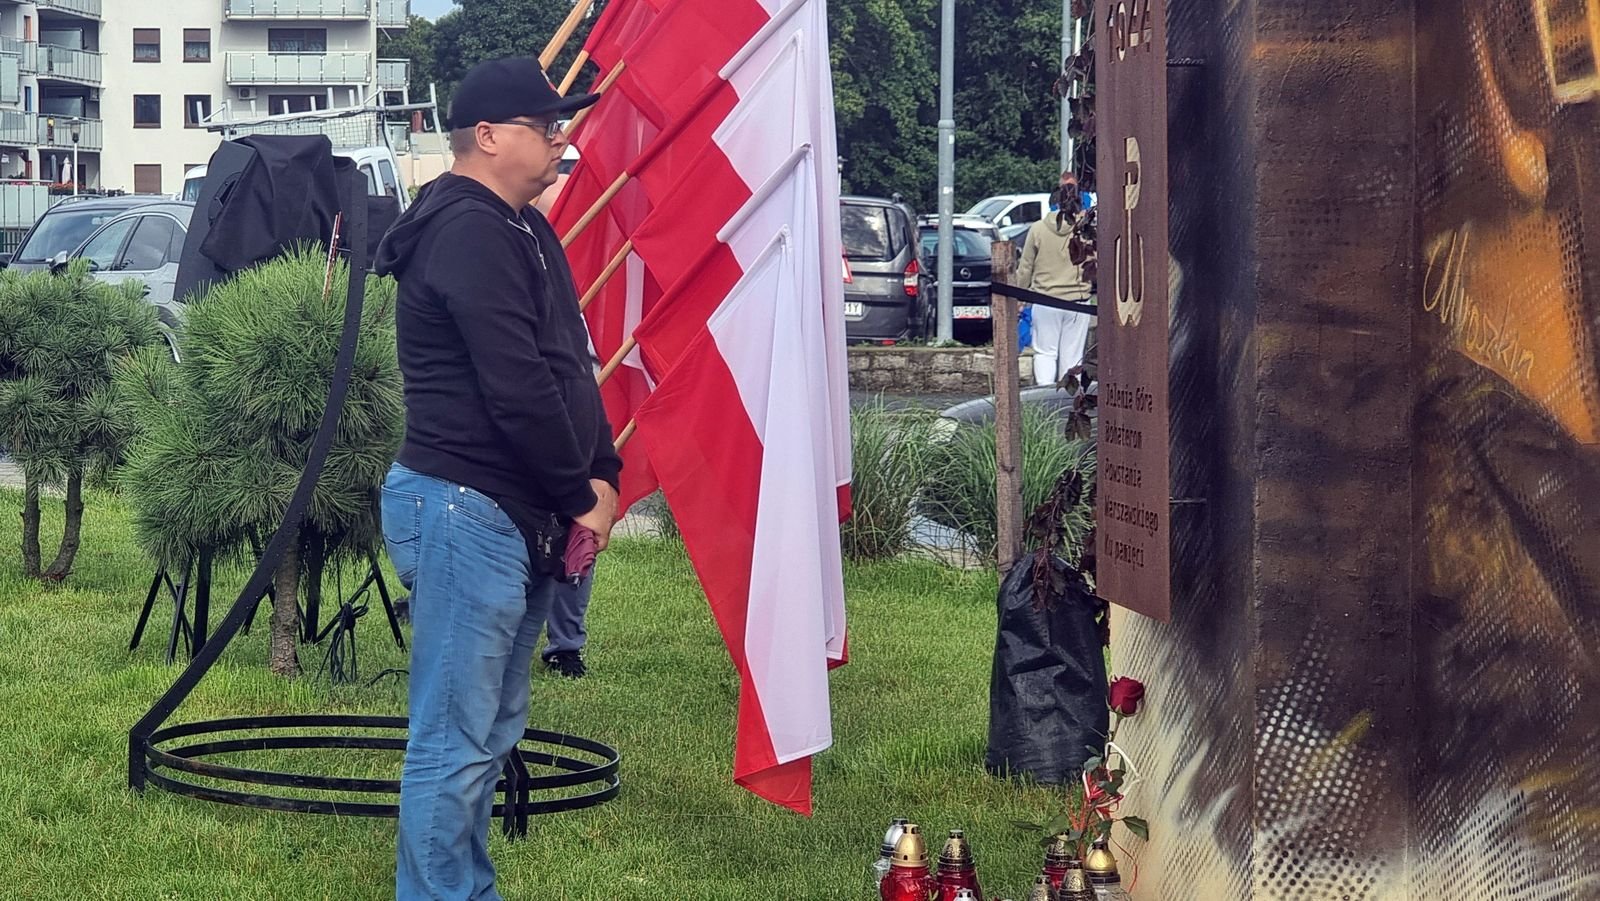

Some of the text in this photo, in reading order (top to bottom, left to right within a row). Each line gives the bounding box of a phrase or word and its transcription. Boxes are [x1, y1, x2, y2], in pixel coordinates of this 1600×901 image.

[1106, 0, 1152, 62] 1944
[1105, 382, 1153, 413] Jelenia Góra
[1105, 420, 1142, 449] Bohaterom
[1104, 457, 1142, 488] Powstania
[1104, 495, 1158, 538] Warszawskiego
[1104, 533, 1144, 570] Ku pamięci
